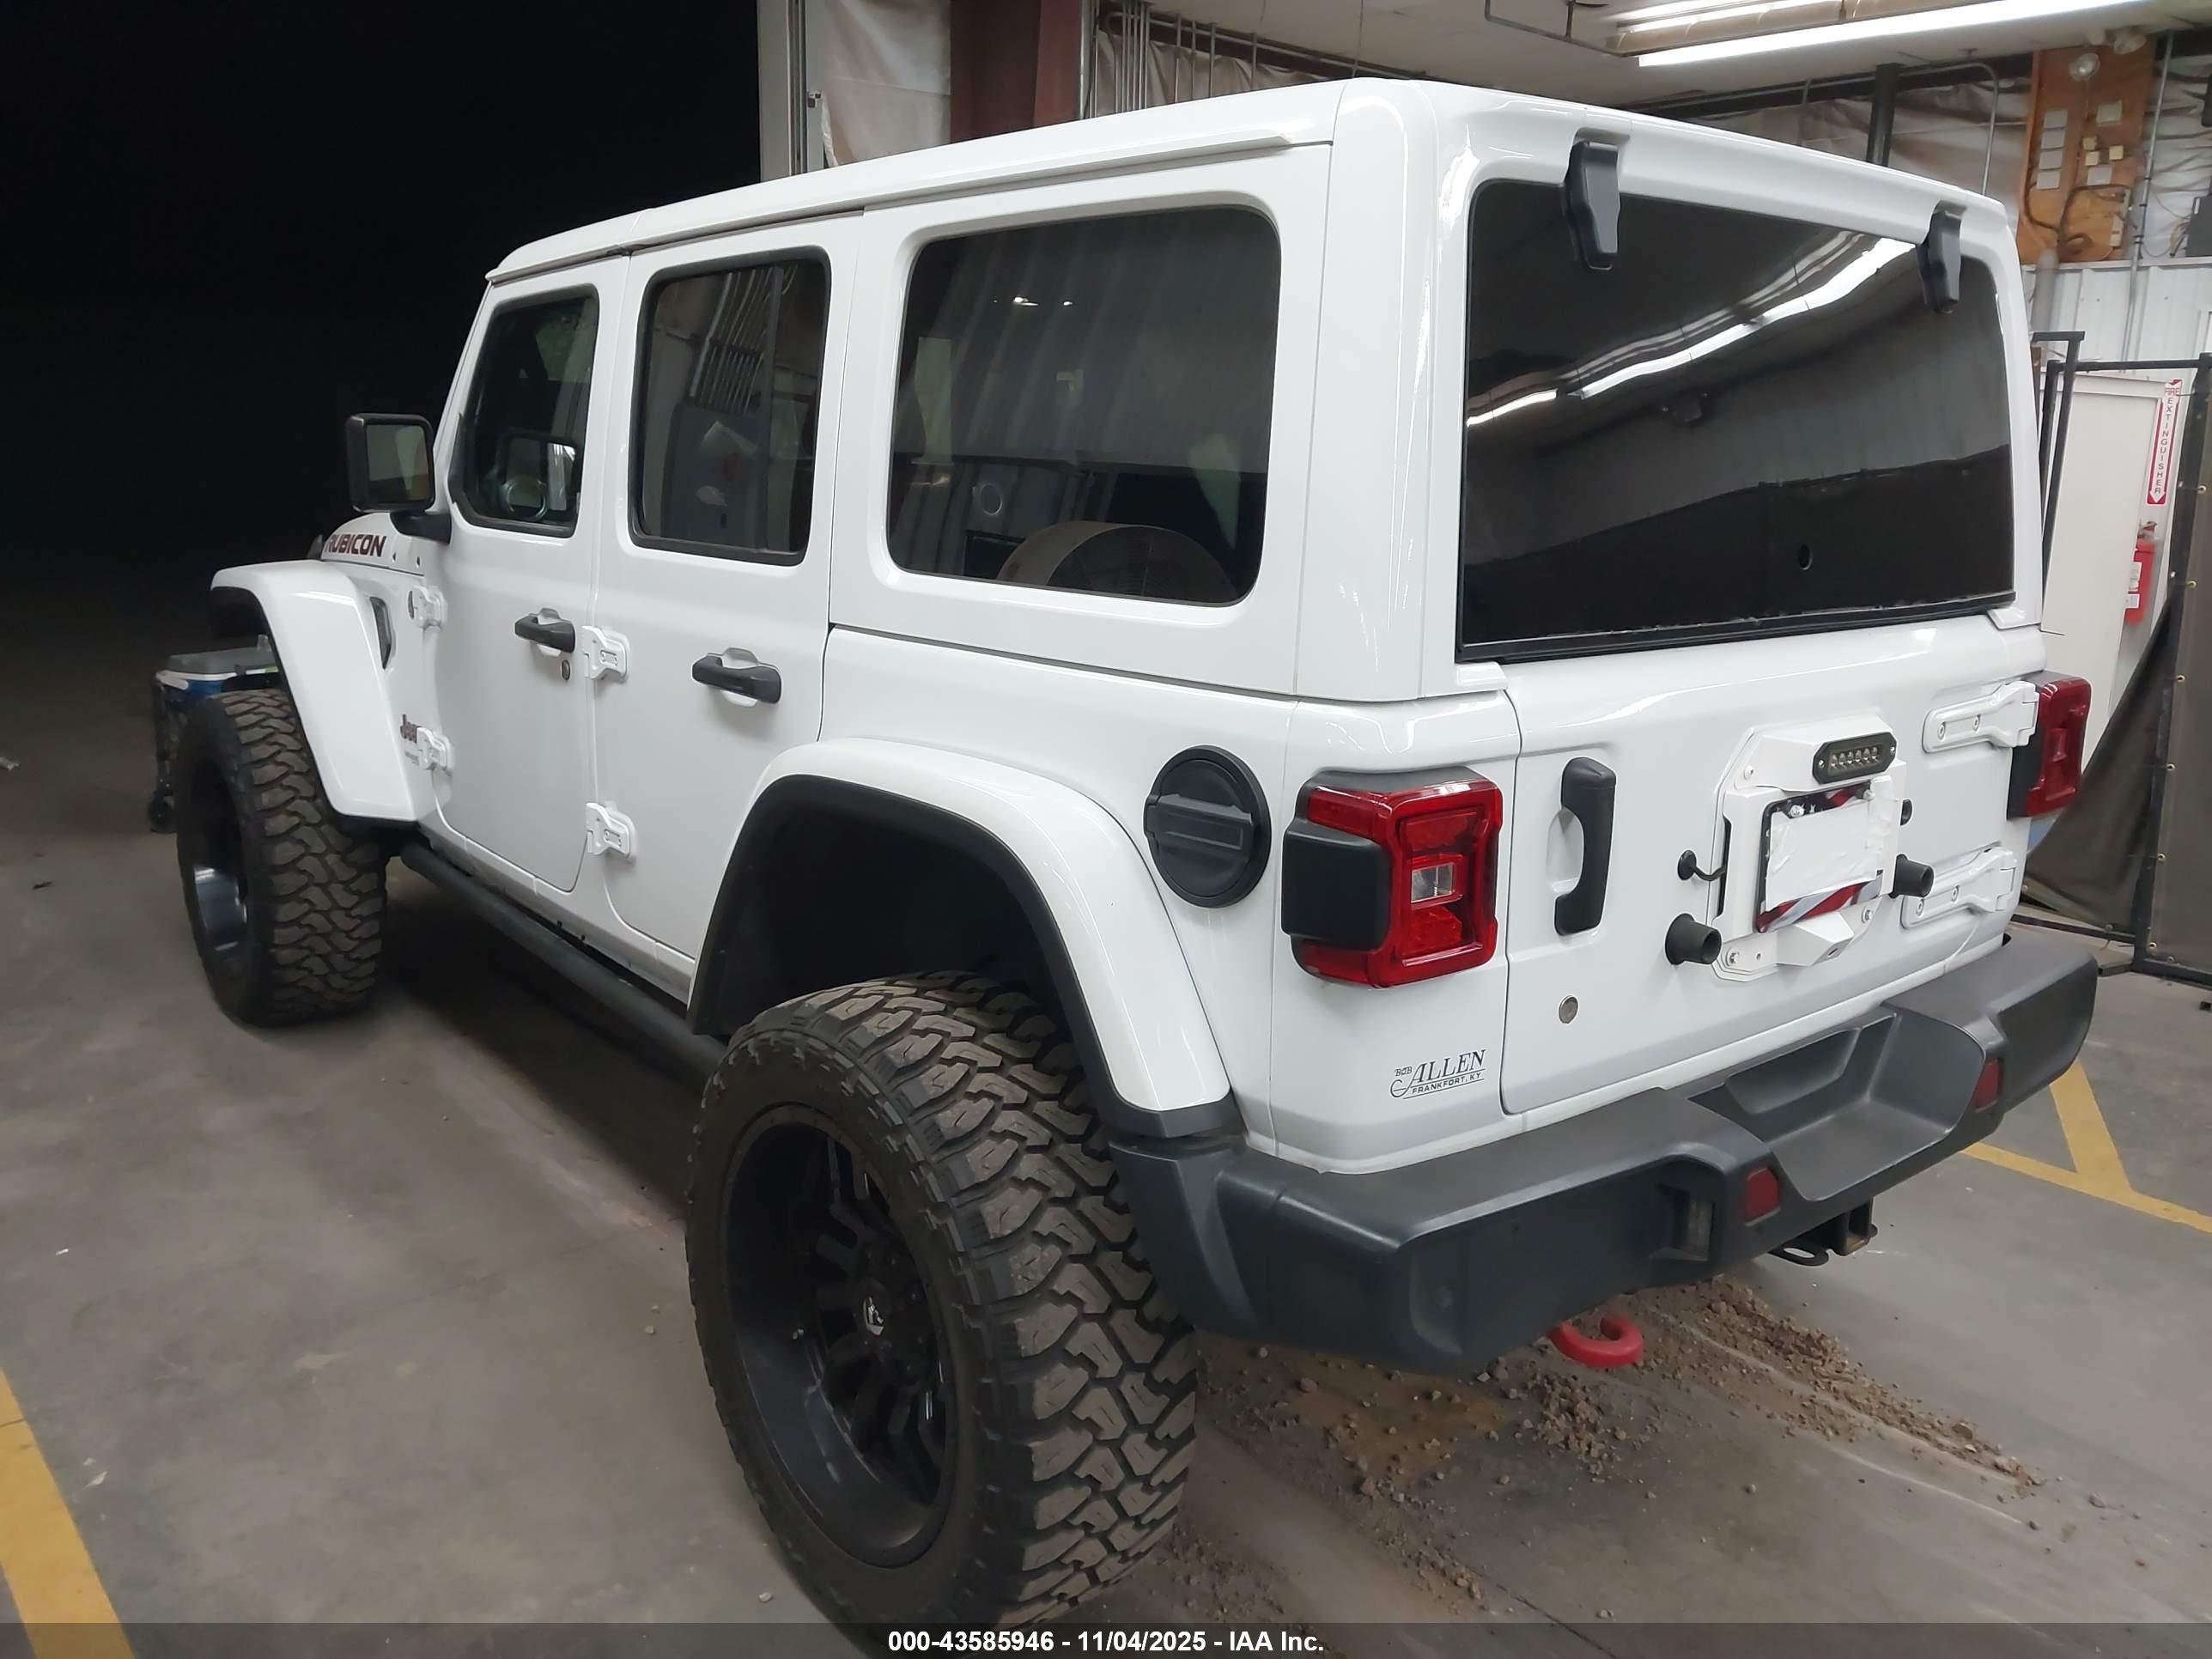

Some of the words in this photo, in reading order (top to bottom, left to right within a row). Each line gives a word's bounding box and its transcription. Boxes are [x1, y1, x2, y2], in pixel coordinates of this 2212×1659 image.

[2164, 387, 2180, 396] FIRE
[2154, 397, 2174, 494] EXTINGUISHER
[324, 533, 387, 557] RUBICON
[1389, 1048, 1486, 1098] ALLEN
[1469, 1072, 1482, 1080] KY
